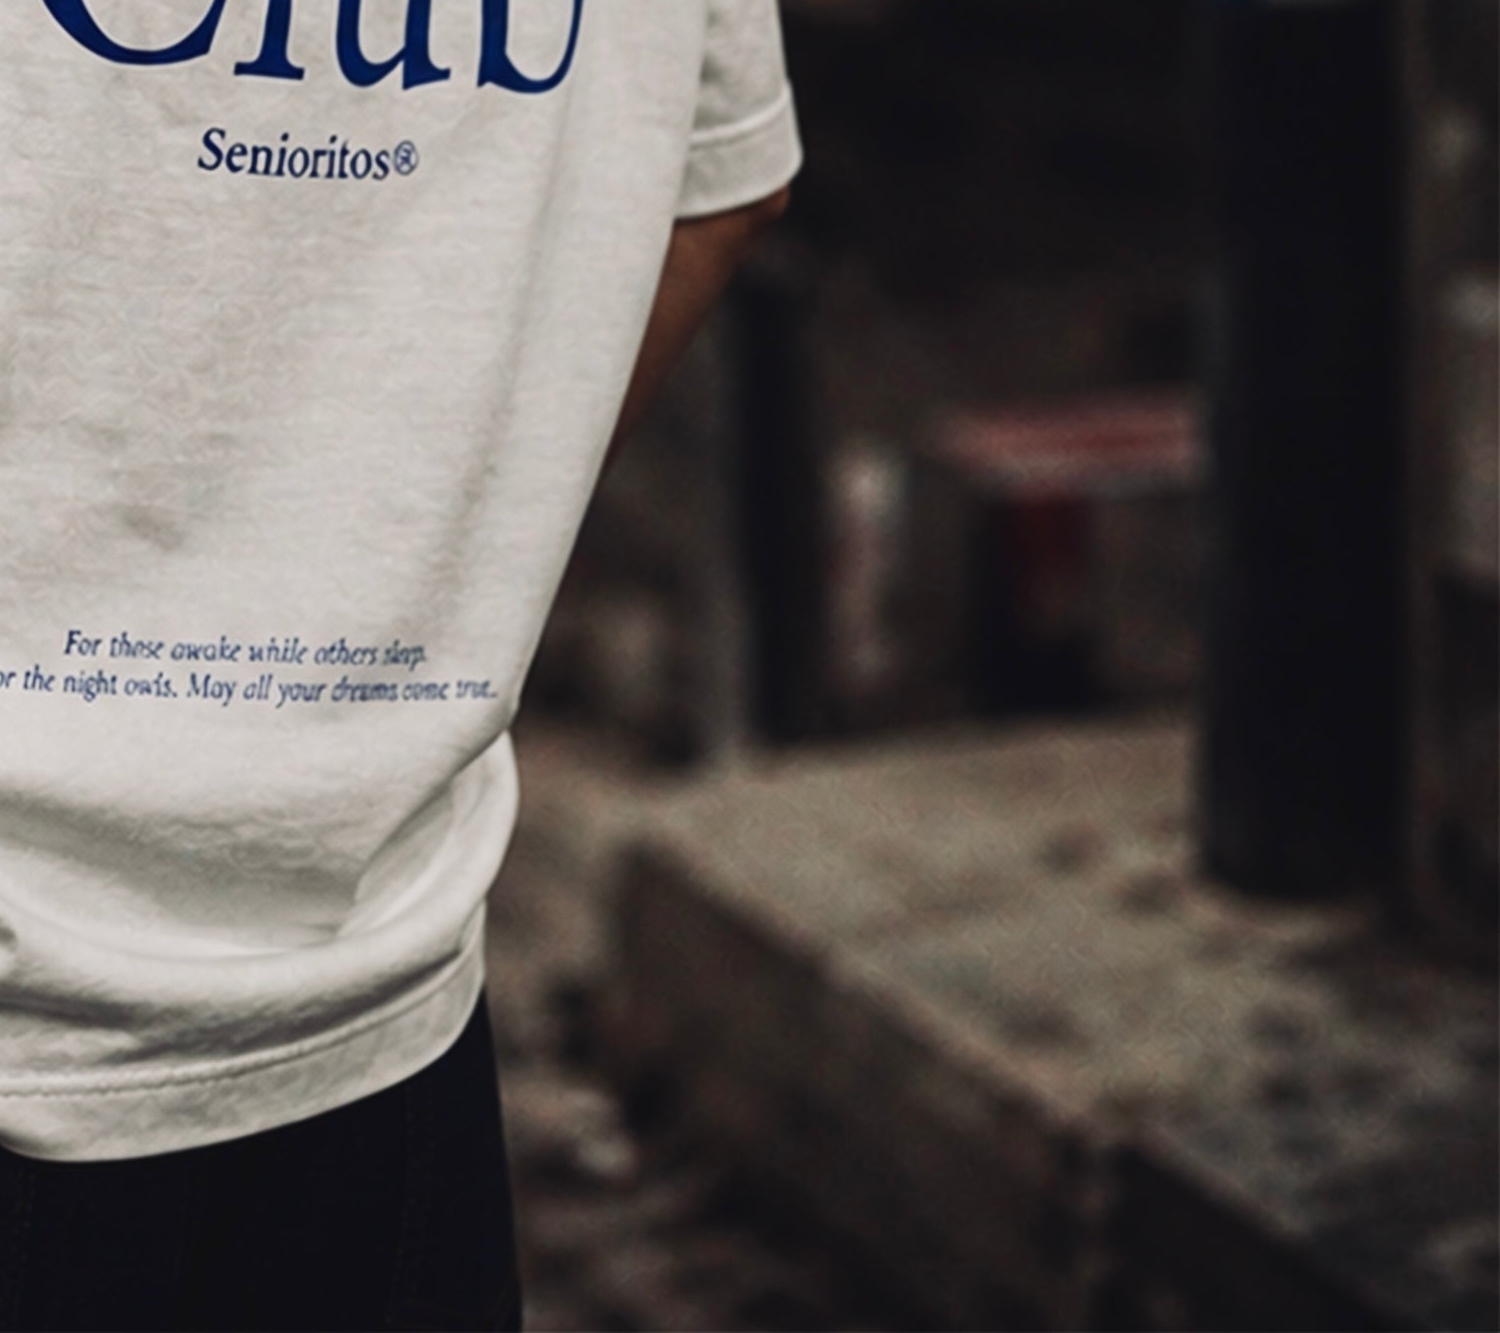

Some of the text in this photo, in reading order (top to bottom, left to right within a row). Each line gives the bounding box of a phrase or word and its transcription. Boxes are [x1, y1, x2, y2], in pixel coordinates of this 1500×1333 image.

[63, 629, 102, 657] For
[109, 631, 165, 660] those
[170, 635, 242, 663] awake
[248, 636, 309, 665] while
[314, 637, 379, 666] others
[23, 663, 56, 692] the
[62, 668, 118, 703] night
[186, 672, 237, 708] May
[242, 673, 274, 701] all
[275, 682, 327, 710] your
